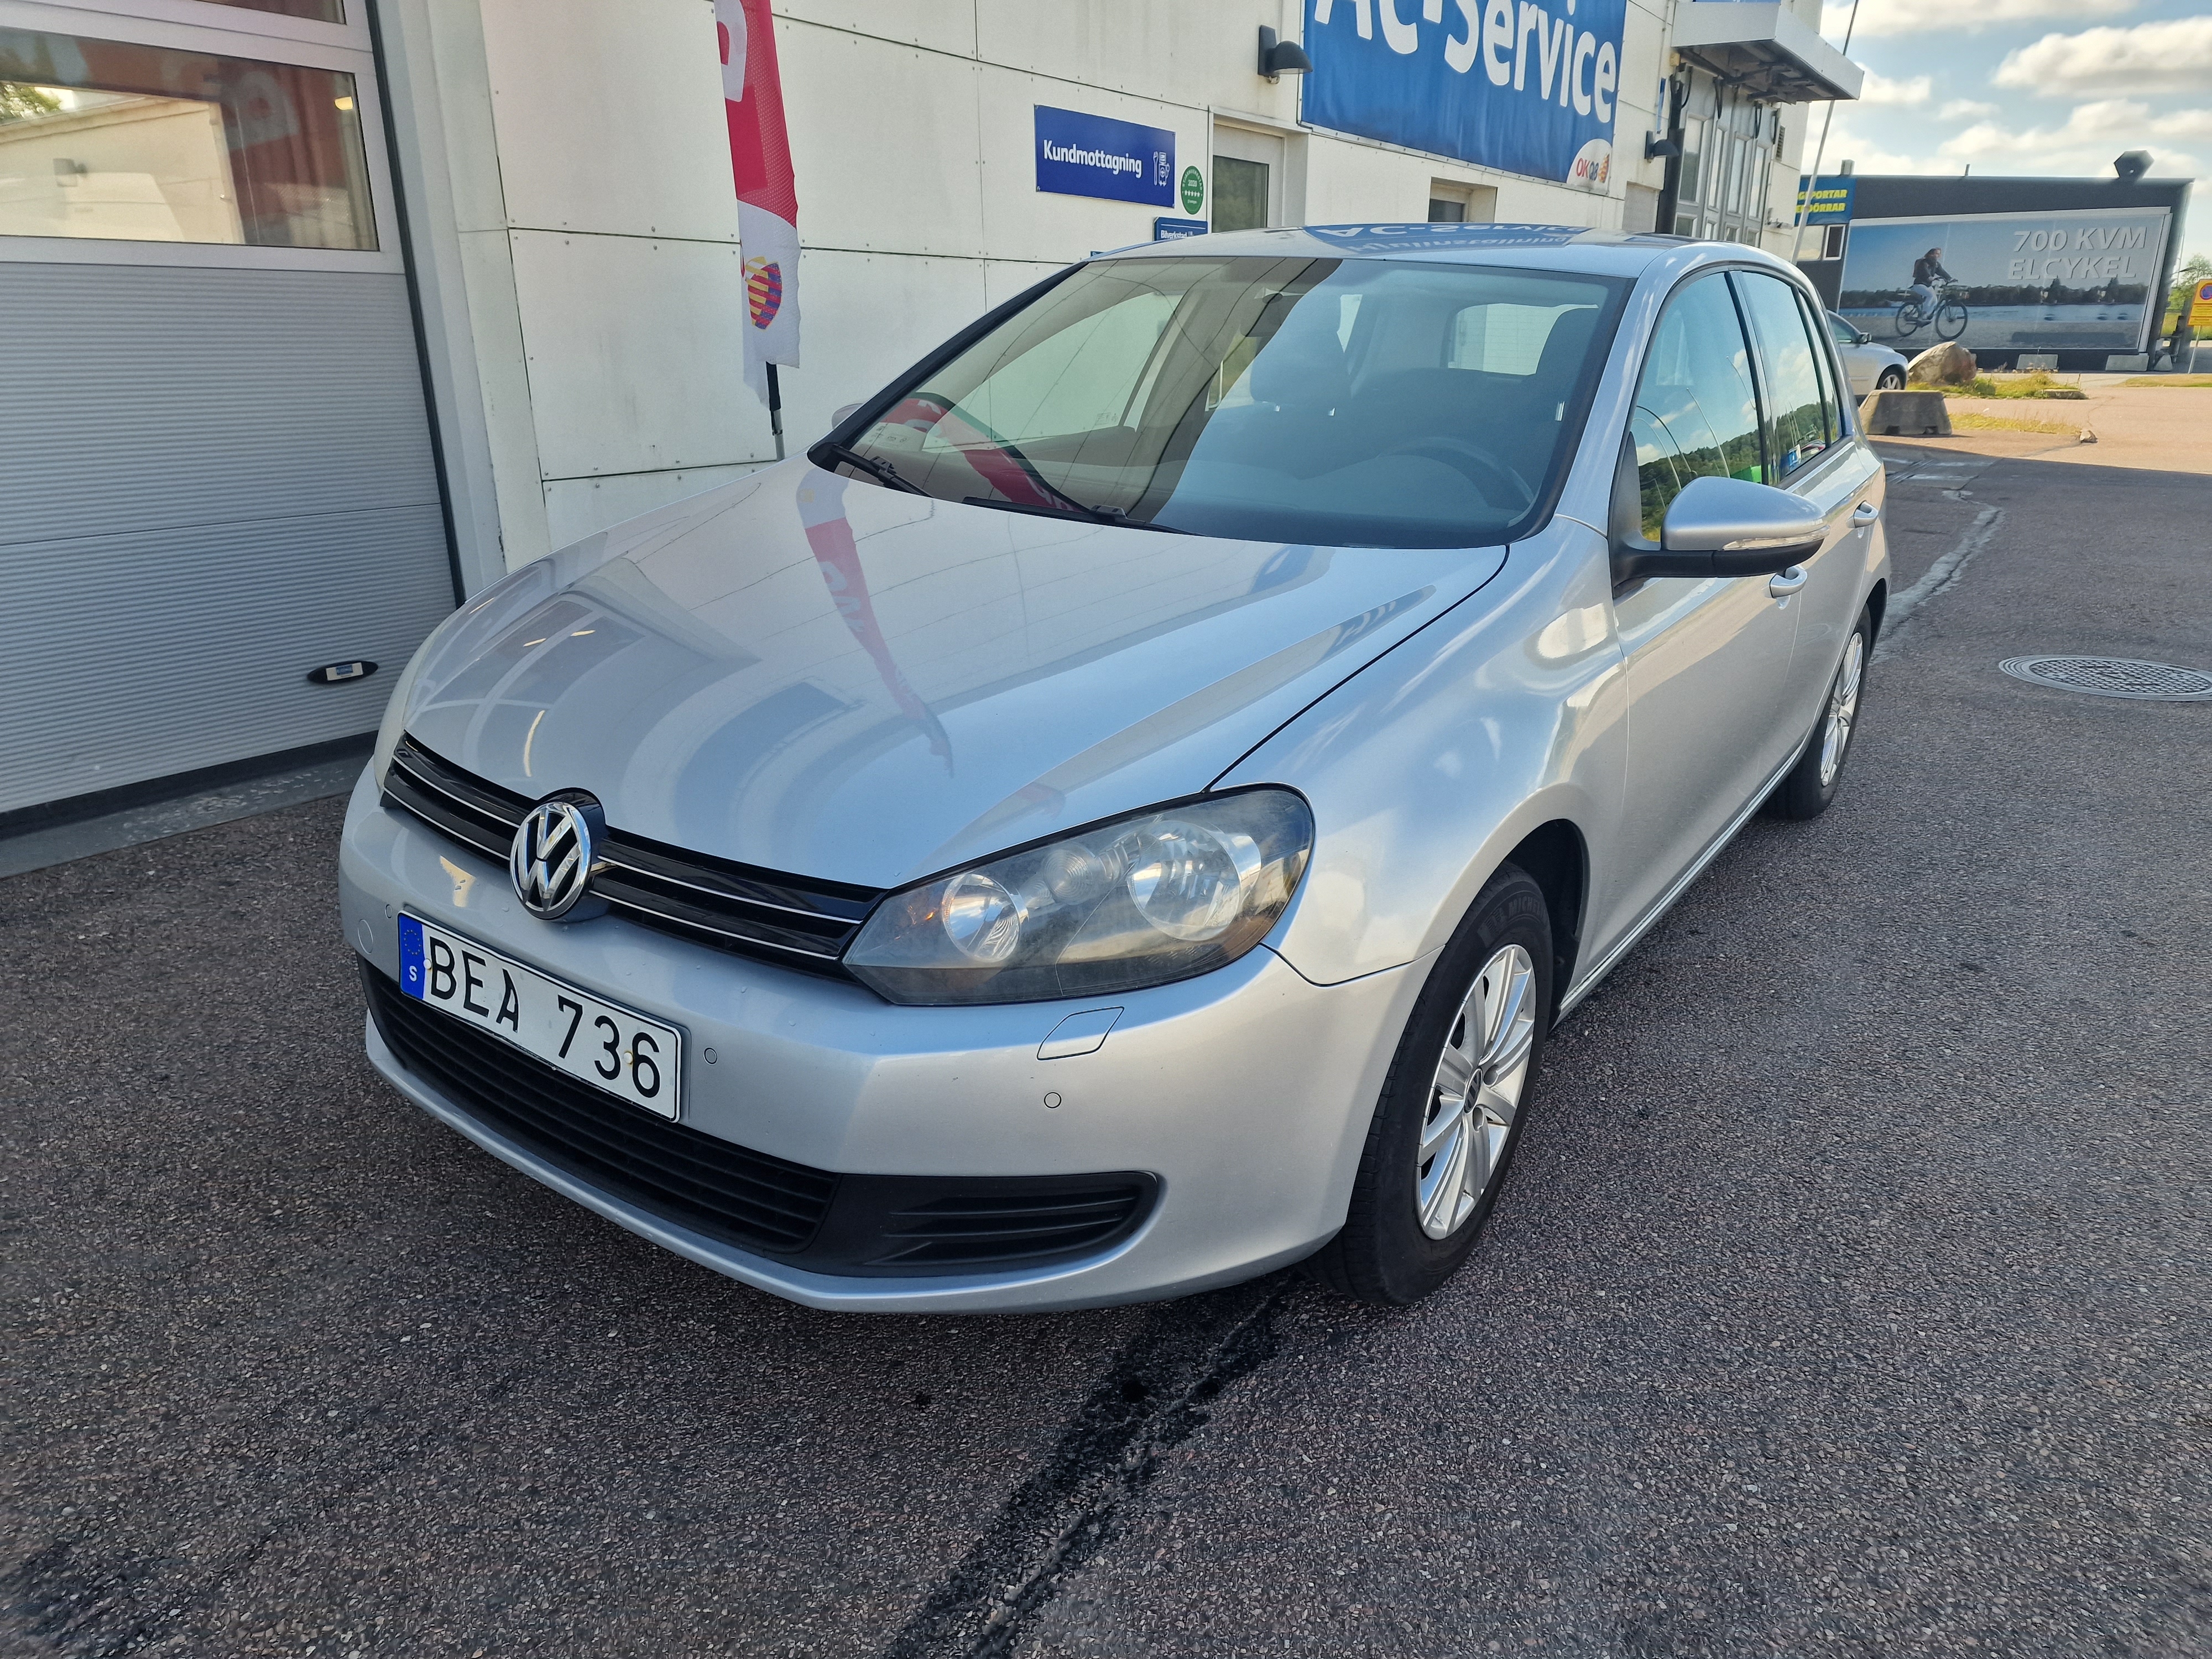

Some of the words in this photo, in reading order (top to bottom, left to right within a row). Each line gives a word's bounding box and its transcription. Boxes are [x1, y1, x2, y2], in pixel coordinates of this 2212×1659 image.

[1044, 139, 1142, 179] Kundmottagning
[1576, 158, 1599, 181] OKQ8
[1161, 229, 1187, 239] Bilverkstad
[2013, 229, 2068, 253] 700
[2075, 227, 2148, 251] KVM
[2008, 256, 2137, 280] ELCYKEL
[408, 965, 418, 982] S
[429, 936, 520, 1033] BEA
[557, 994, 661, 1099] 736
